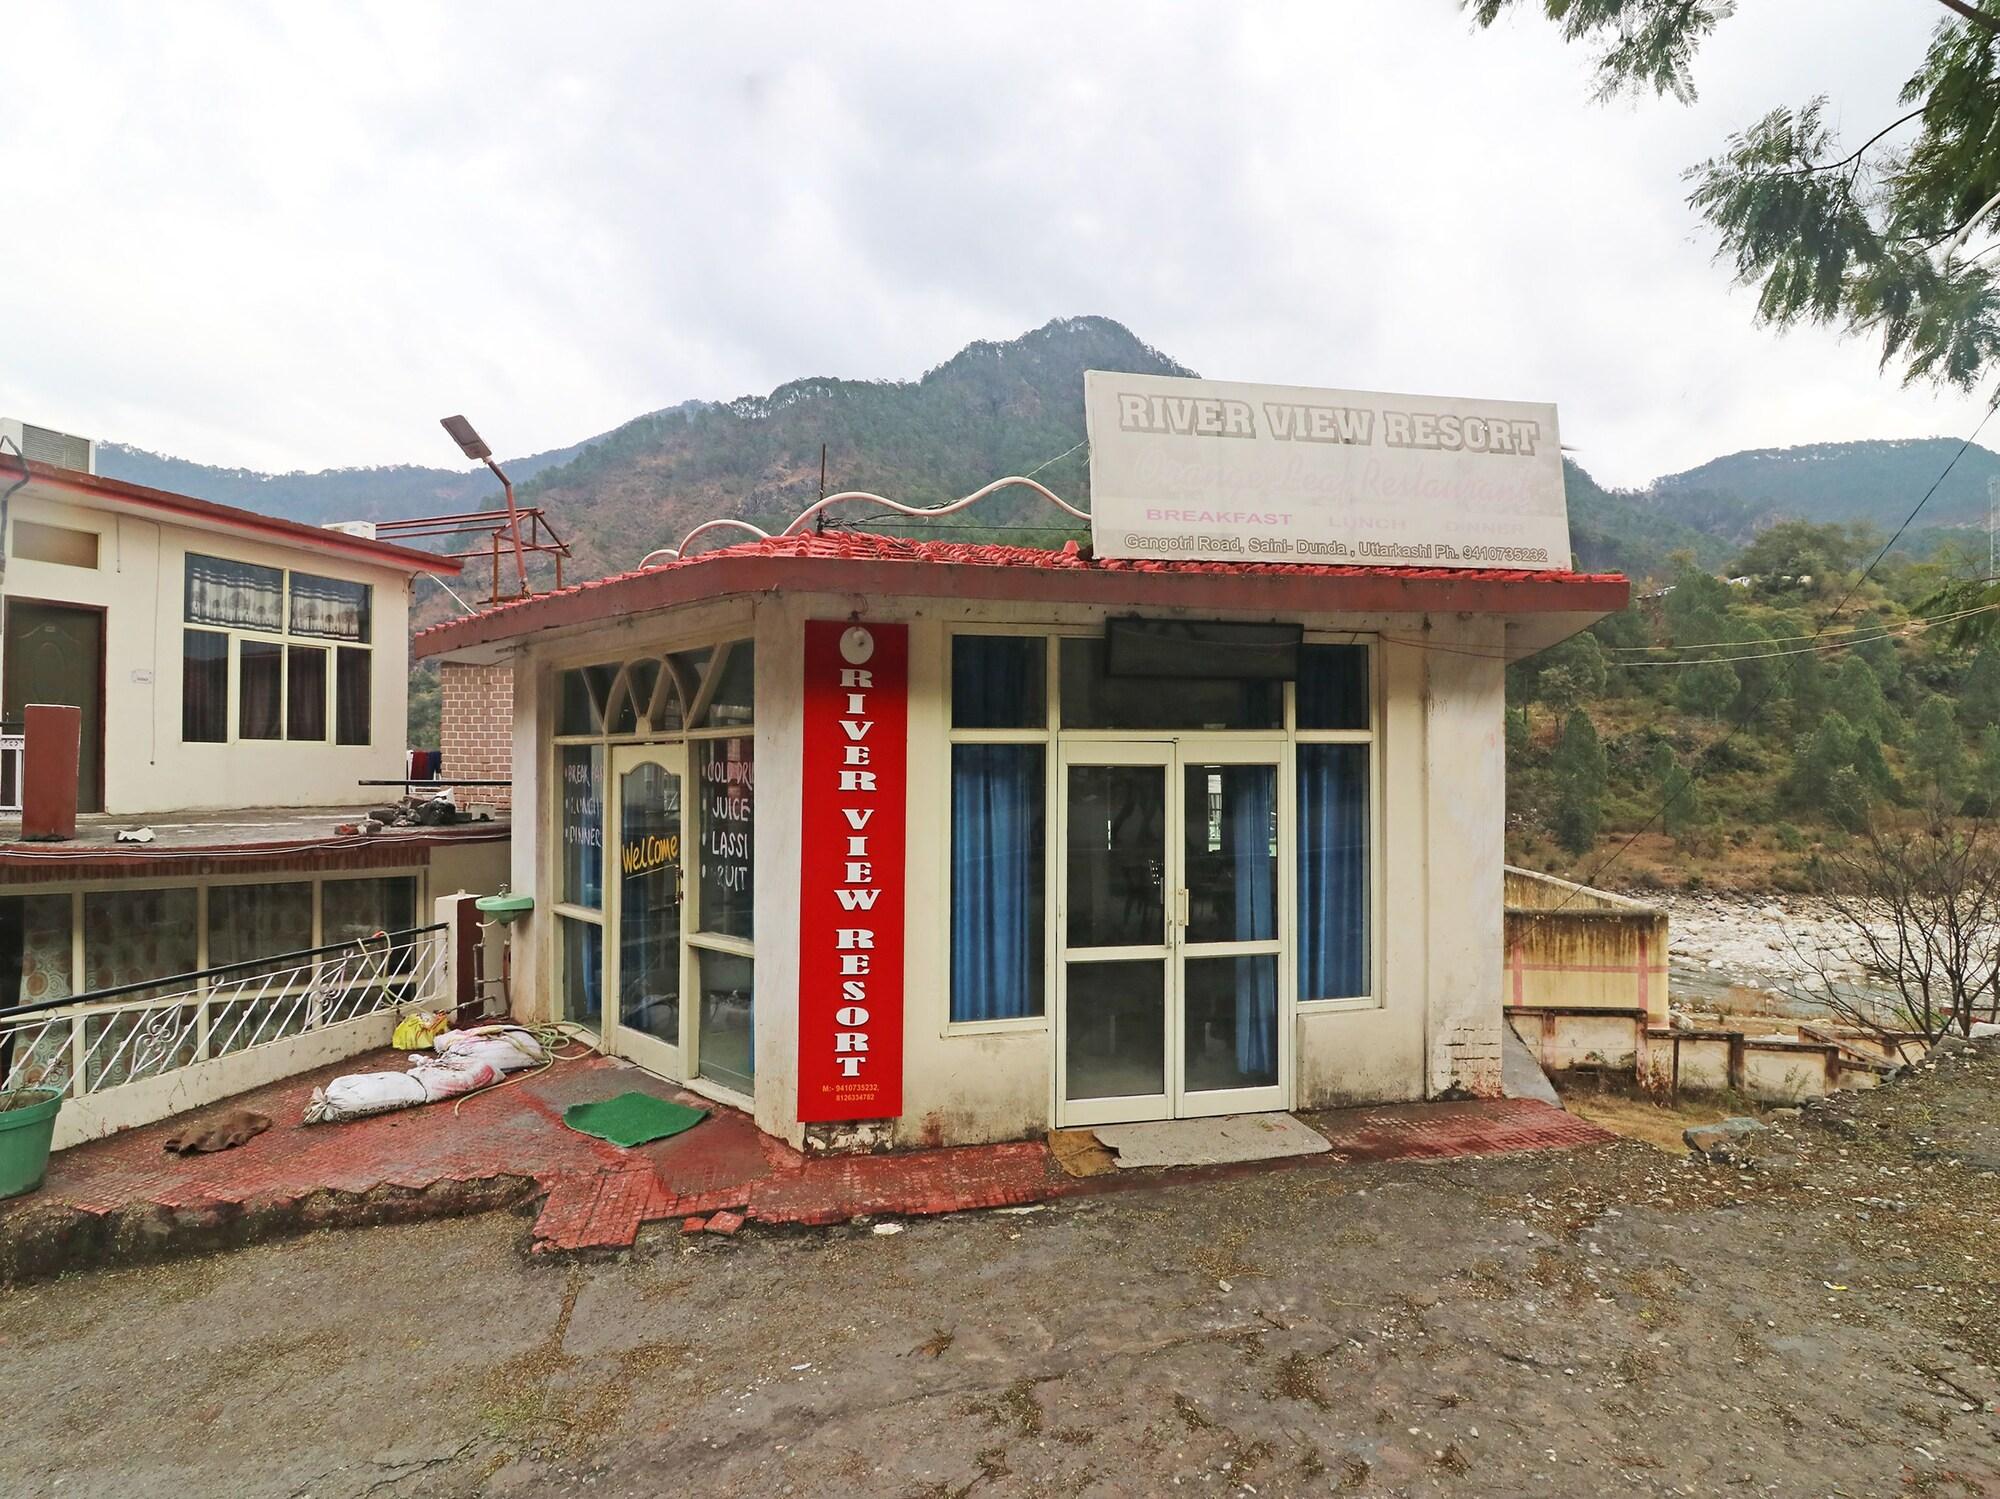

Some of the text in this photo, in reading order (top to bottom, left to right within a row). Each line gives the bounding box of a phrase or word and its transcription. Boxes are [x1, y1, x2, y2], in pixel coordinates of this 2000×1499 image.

[1118, 392, 1539, 456] RIVER VIEW RESORT
[1146, 508, 1524, 536] BREAKFAST LUNCH DINNER
[1125, 534, 1193, 551] Gangotri
[1198, 536, 1244, 553] Road,
[1249, 538, 1293, 553] Saini-
[1359, 542, 1431, 558] Uttarkashi
[1435, 544, 1459, 559] Ph.
[1463, 545, 1547, 562] 9410735232
[736, 761, 754, 791] DRI
[712, 796, 751, 821] JUICE
[712, 831, 748, 860] LASSI
[834, 669, 882, 1077] RIVER VIEW RESORT
